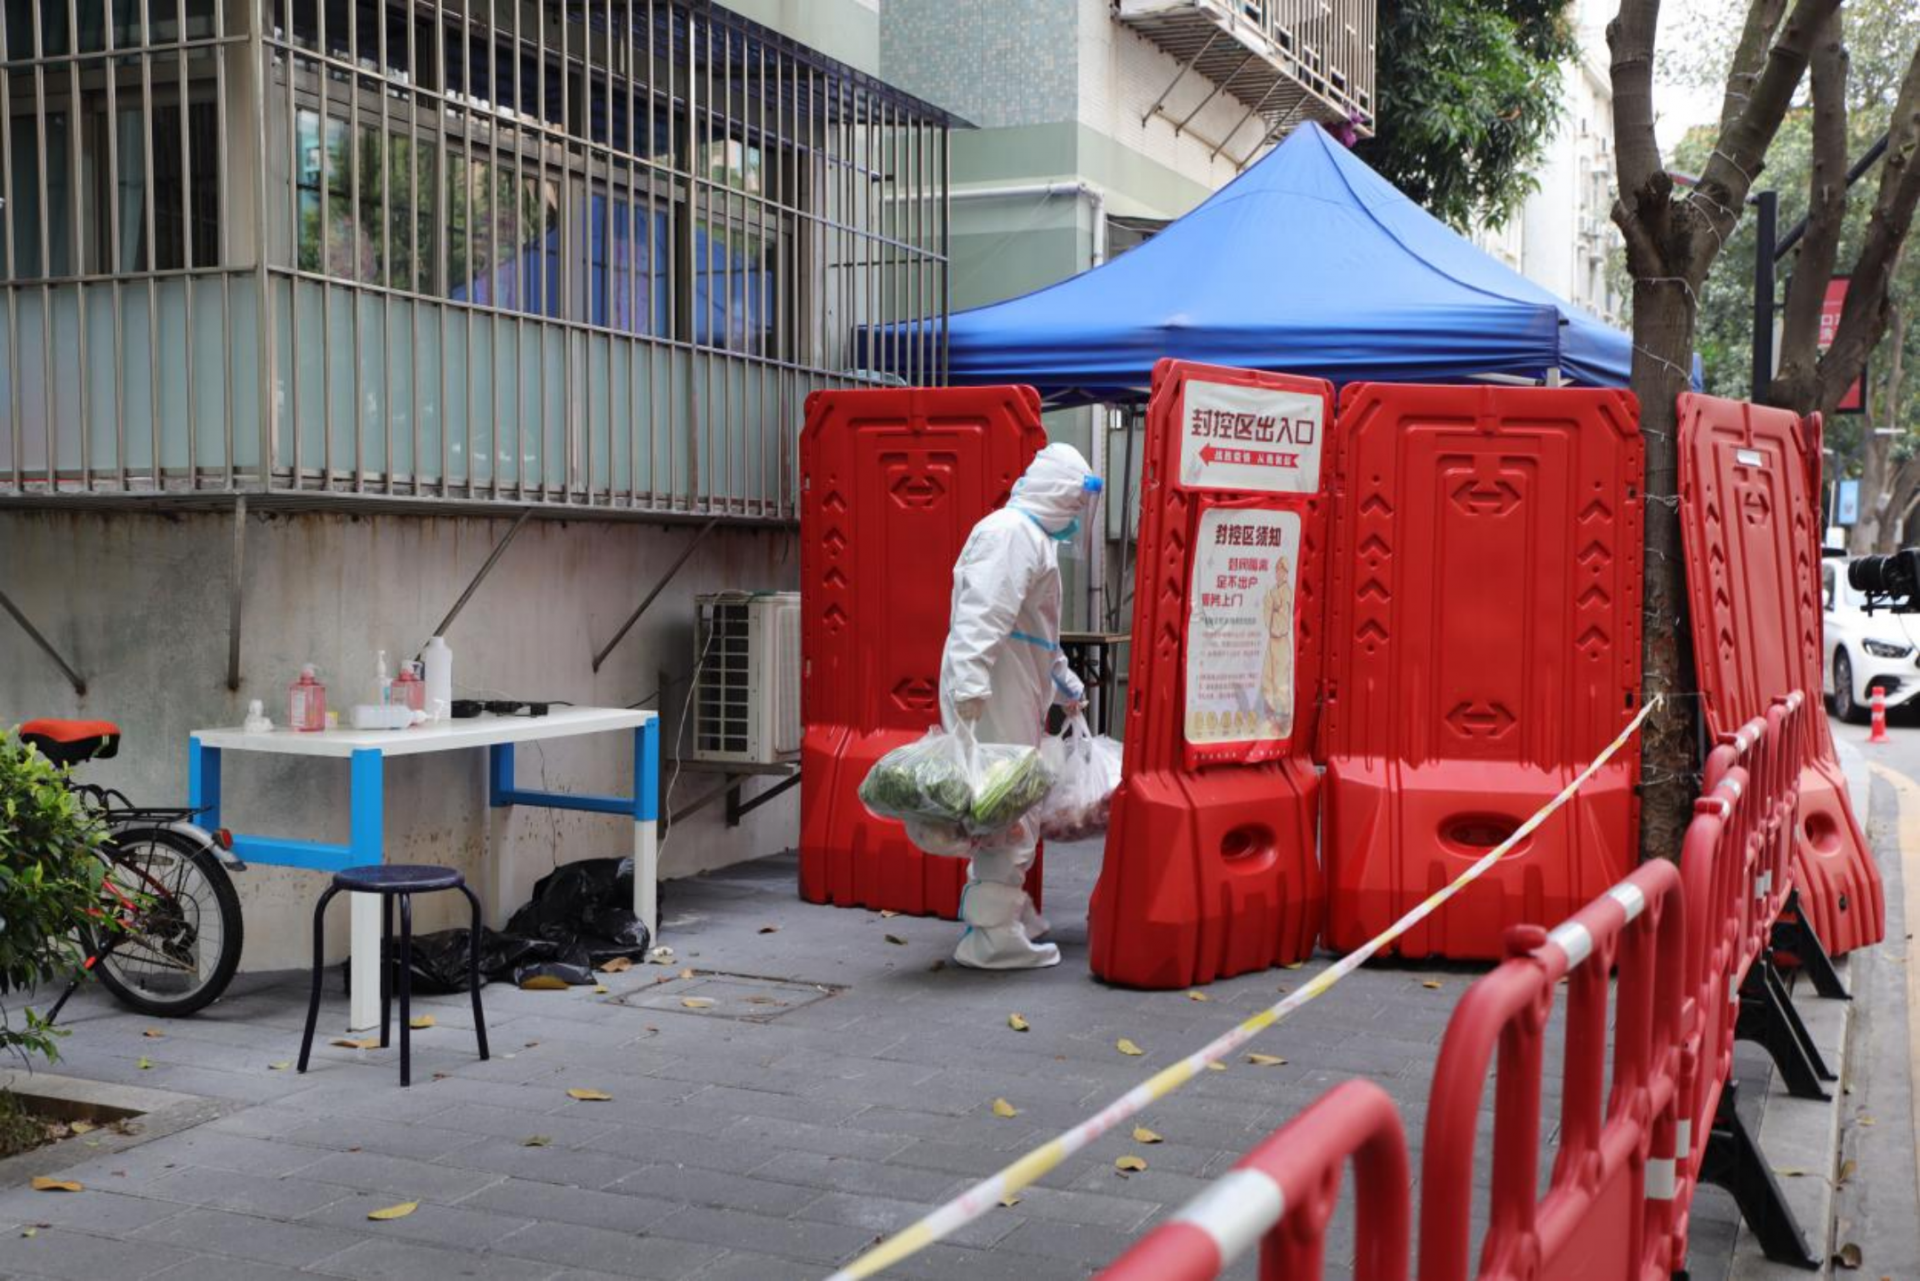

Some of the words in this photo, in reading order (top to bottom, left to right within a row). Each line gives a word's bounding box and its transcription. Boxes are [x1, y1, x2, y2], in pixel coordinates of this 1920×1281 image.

[1191, 408, 1315, 445] 封控区出入口
[1215, 524, 1282, 547] 封控区须知
[1216, 575, 1258, 589] 足不出户
